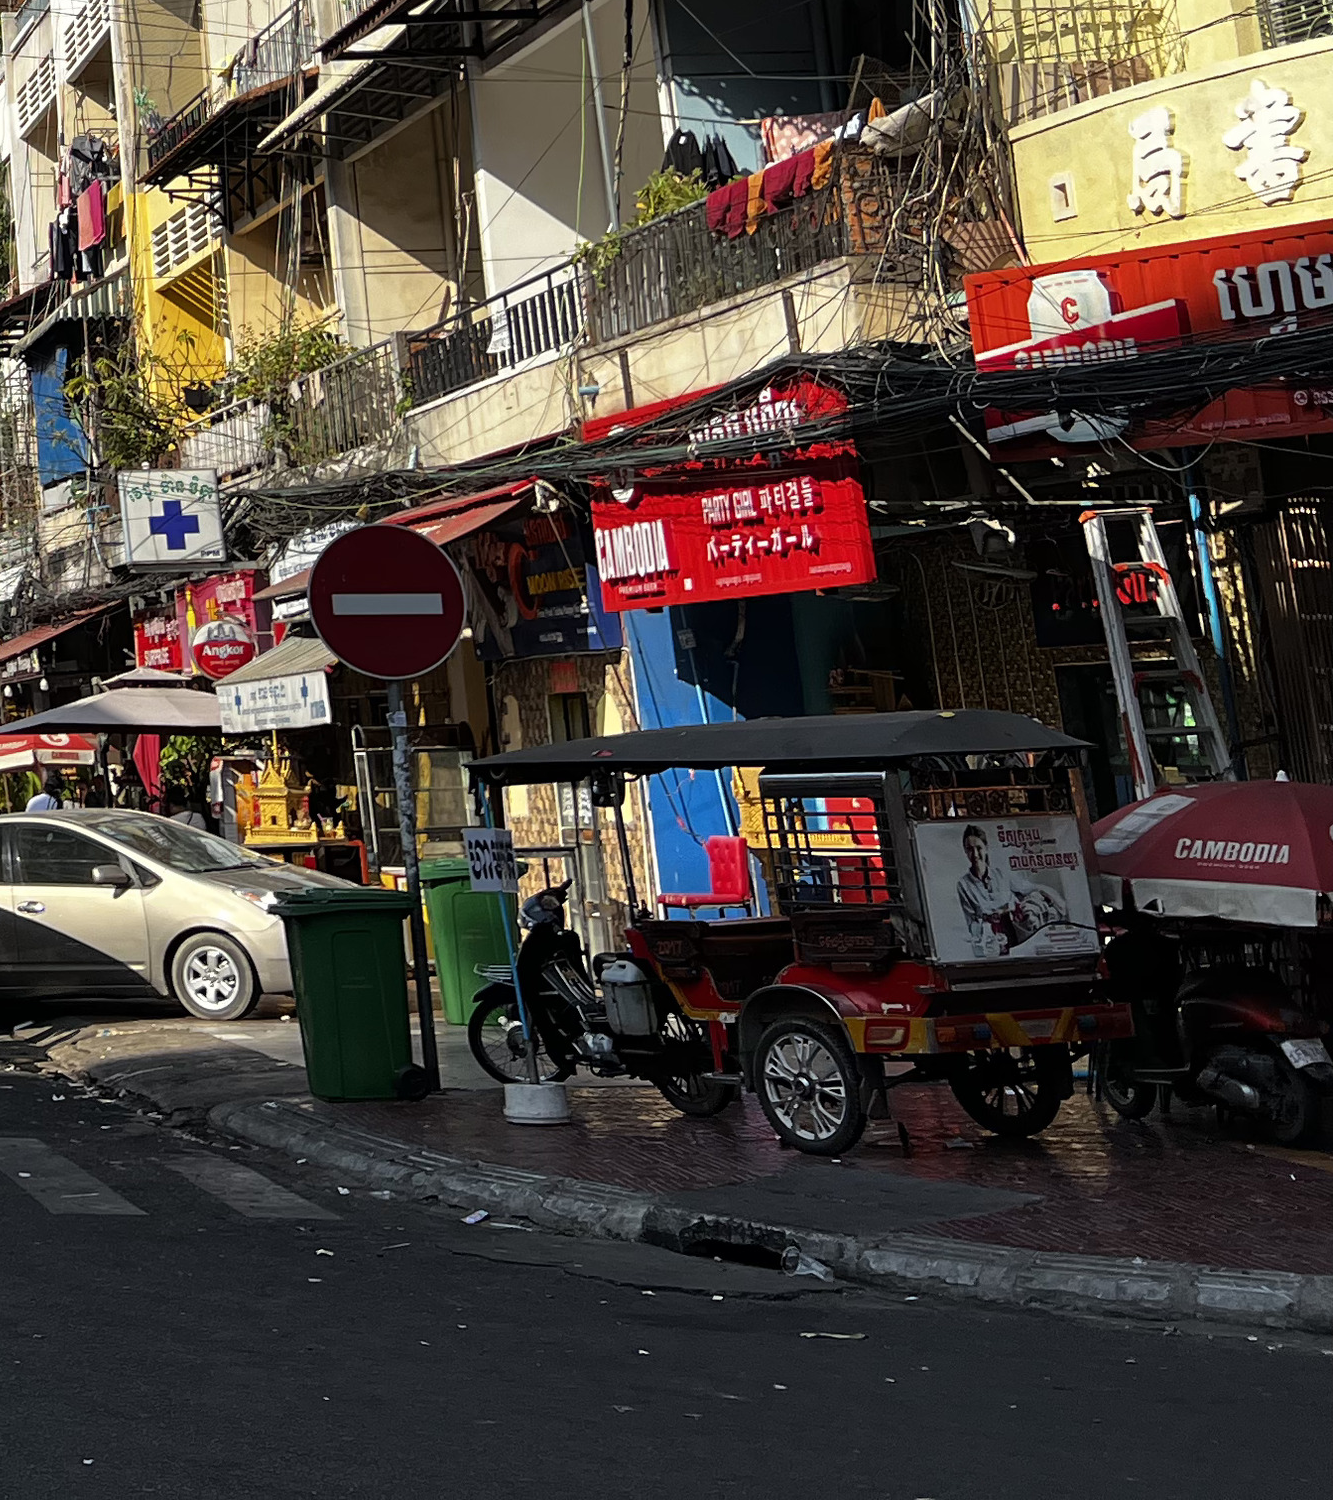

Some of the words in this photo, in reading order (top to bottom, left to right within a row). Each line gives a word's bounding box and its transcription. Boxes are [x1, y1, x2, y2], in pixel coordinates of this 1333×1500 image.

[702, 493, 731, 524] PARTY
[733, 489, 758, 520] GIRL
[595, 519, 670, 582] CAMBODIA
[202, 643, 245, 659] Angkor
[1174, 838, 1290, 864] CAMBODIA
